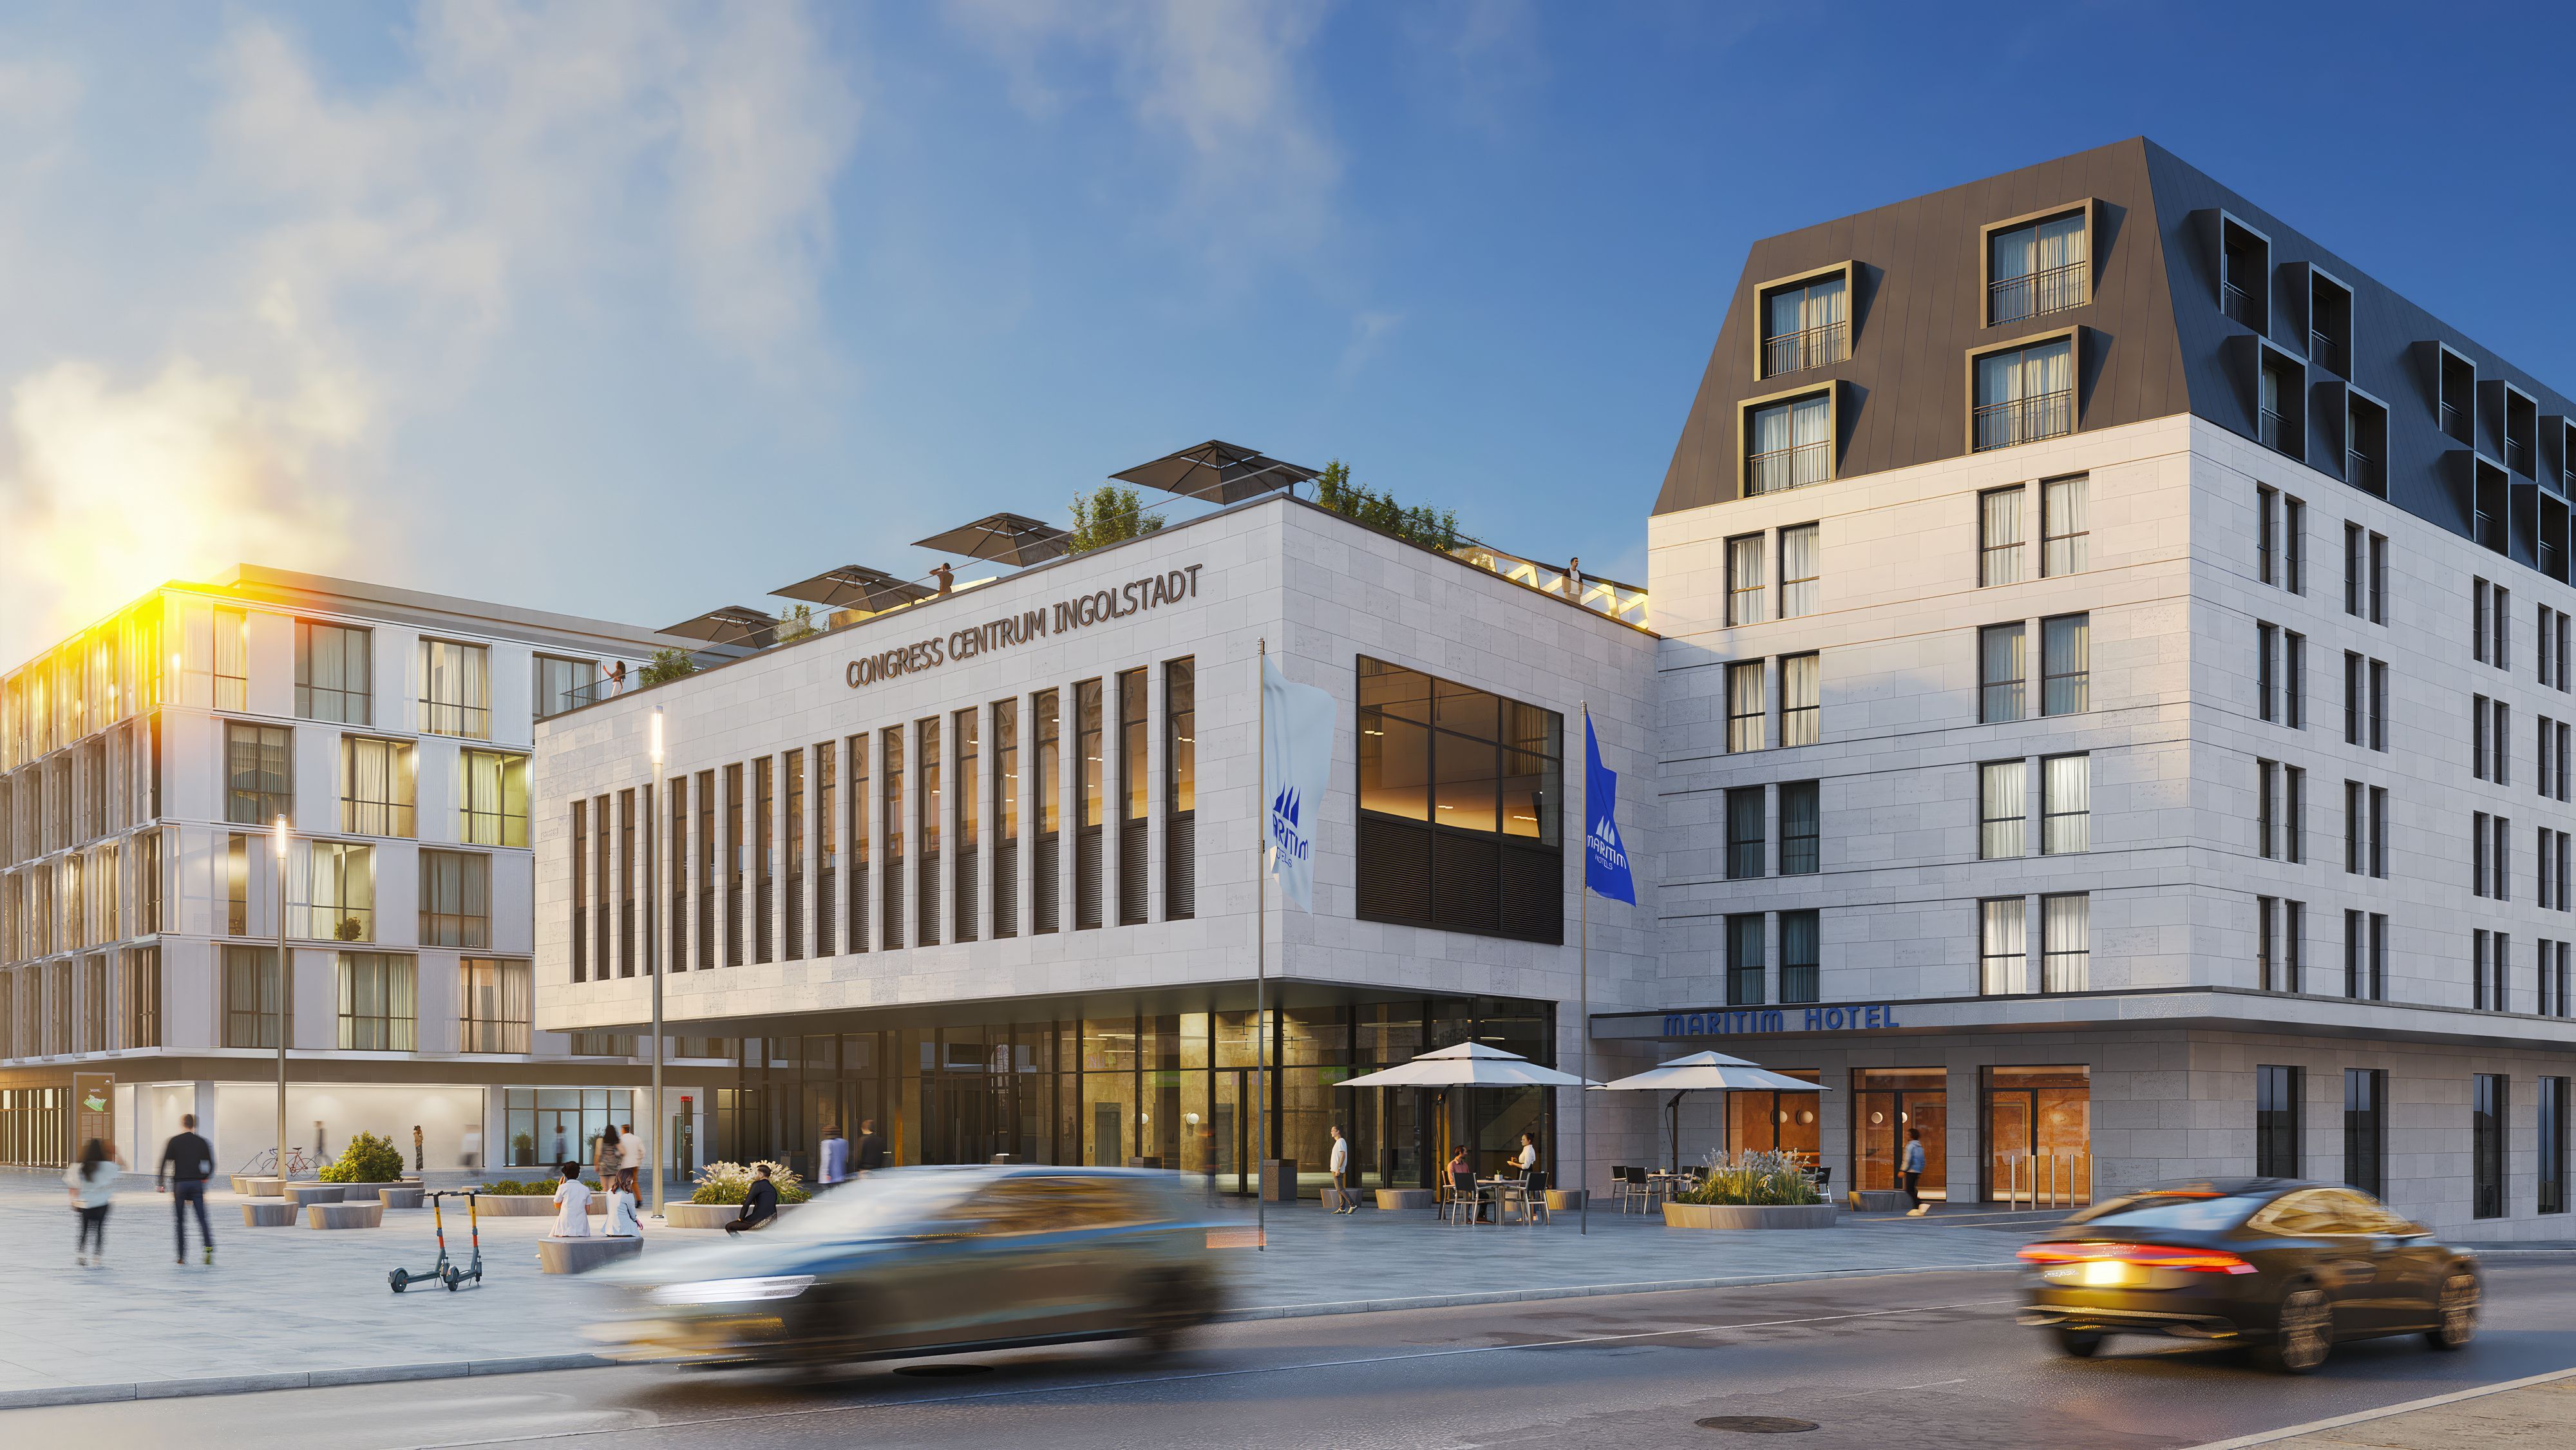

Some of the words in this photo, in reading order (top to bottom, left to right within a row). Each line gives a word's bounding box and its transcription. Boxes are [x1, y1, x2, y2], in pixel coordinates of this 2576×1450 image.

[846, 637, 943, 689] CONGRESS
[948, 607, 1046, 662] CENTRUM
[1053, 563, 1203, 634] INGOLSTADT
[1273, 813, 1308, 861] ARITIM
[1587, 835, 1627, 870] MARITIM
[1663, 1009, 1783, 1036] MARITIM
[1805, 1004, 1899, 1031] HOTEL
